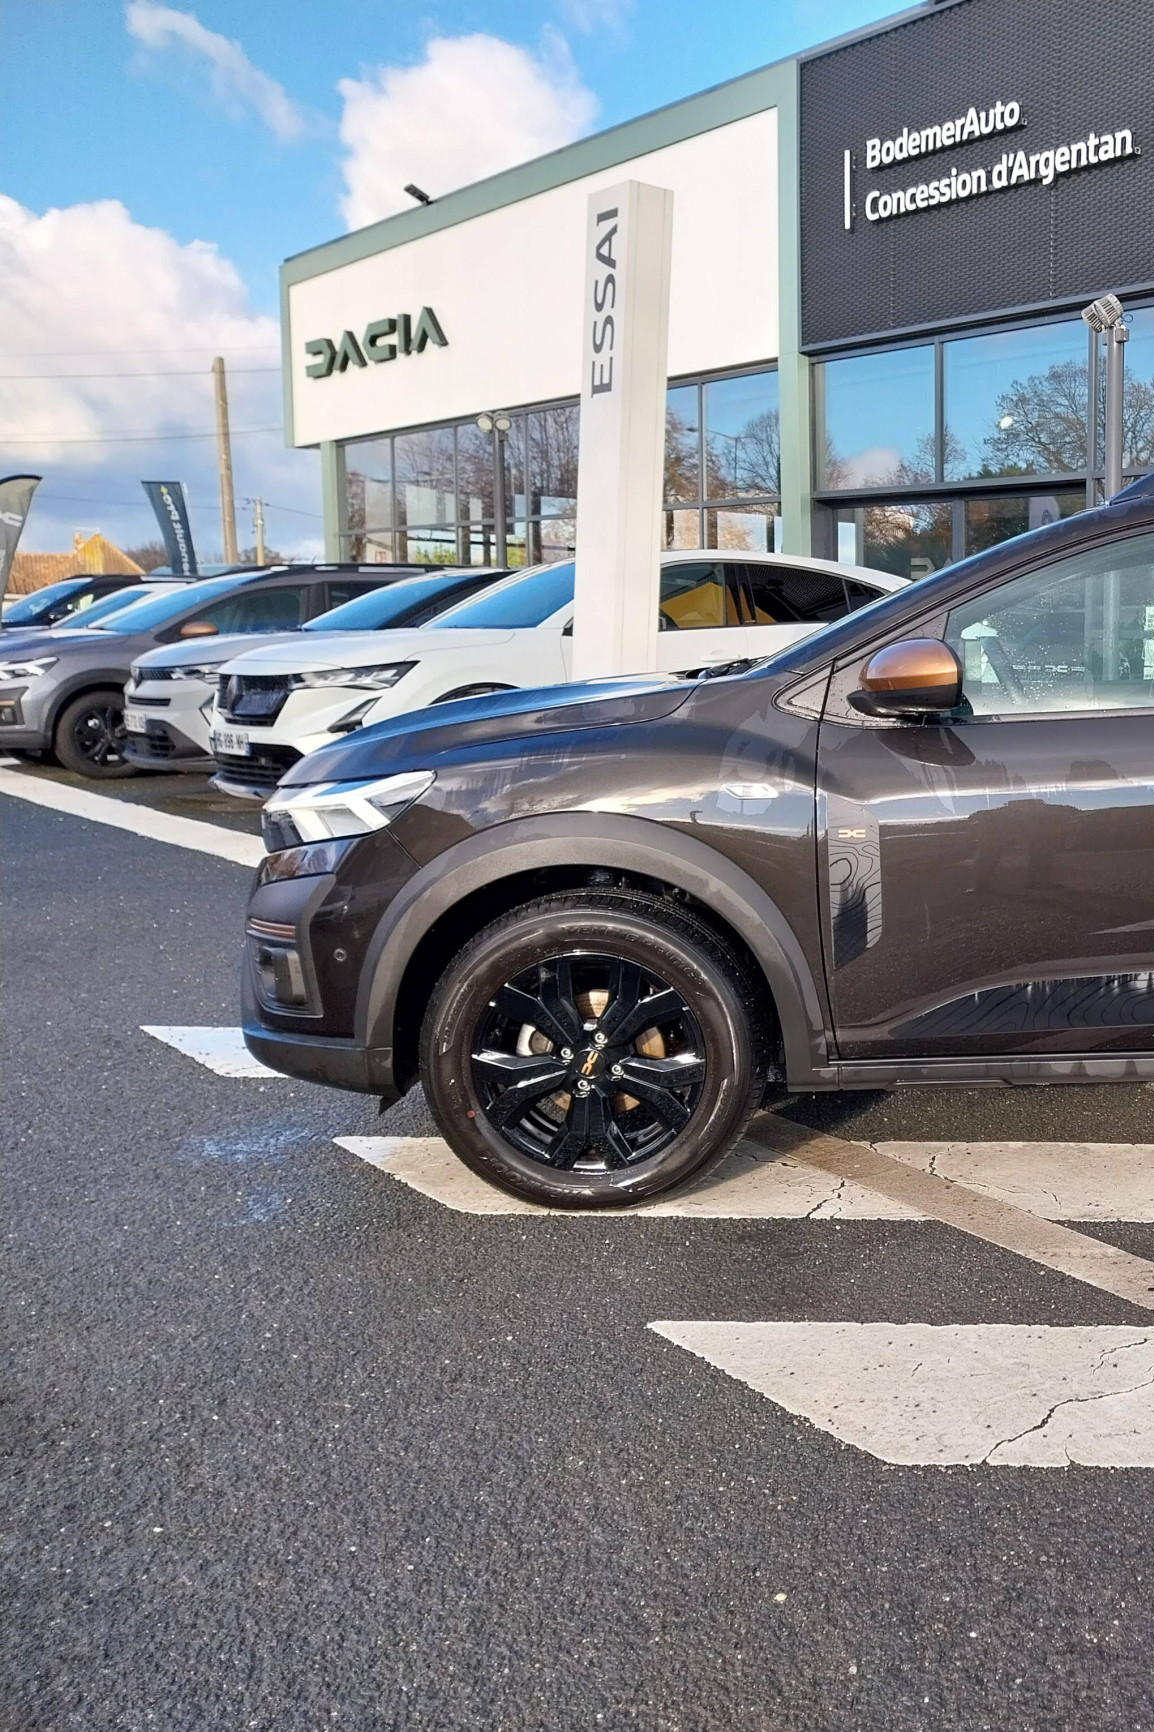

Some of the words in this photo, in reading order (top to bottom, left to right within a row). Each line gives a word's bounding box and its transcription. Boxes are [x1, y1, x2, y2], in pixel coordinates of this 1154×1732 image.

[864, 167, 988, 221] Concession
[991, 128, 1134, 185] d'Argentan
[865, 100, 1021, 169] BodemerAuto
[305, 305, 449, 379] DACIA
[591, 206, 619, 398] ESSAI
